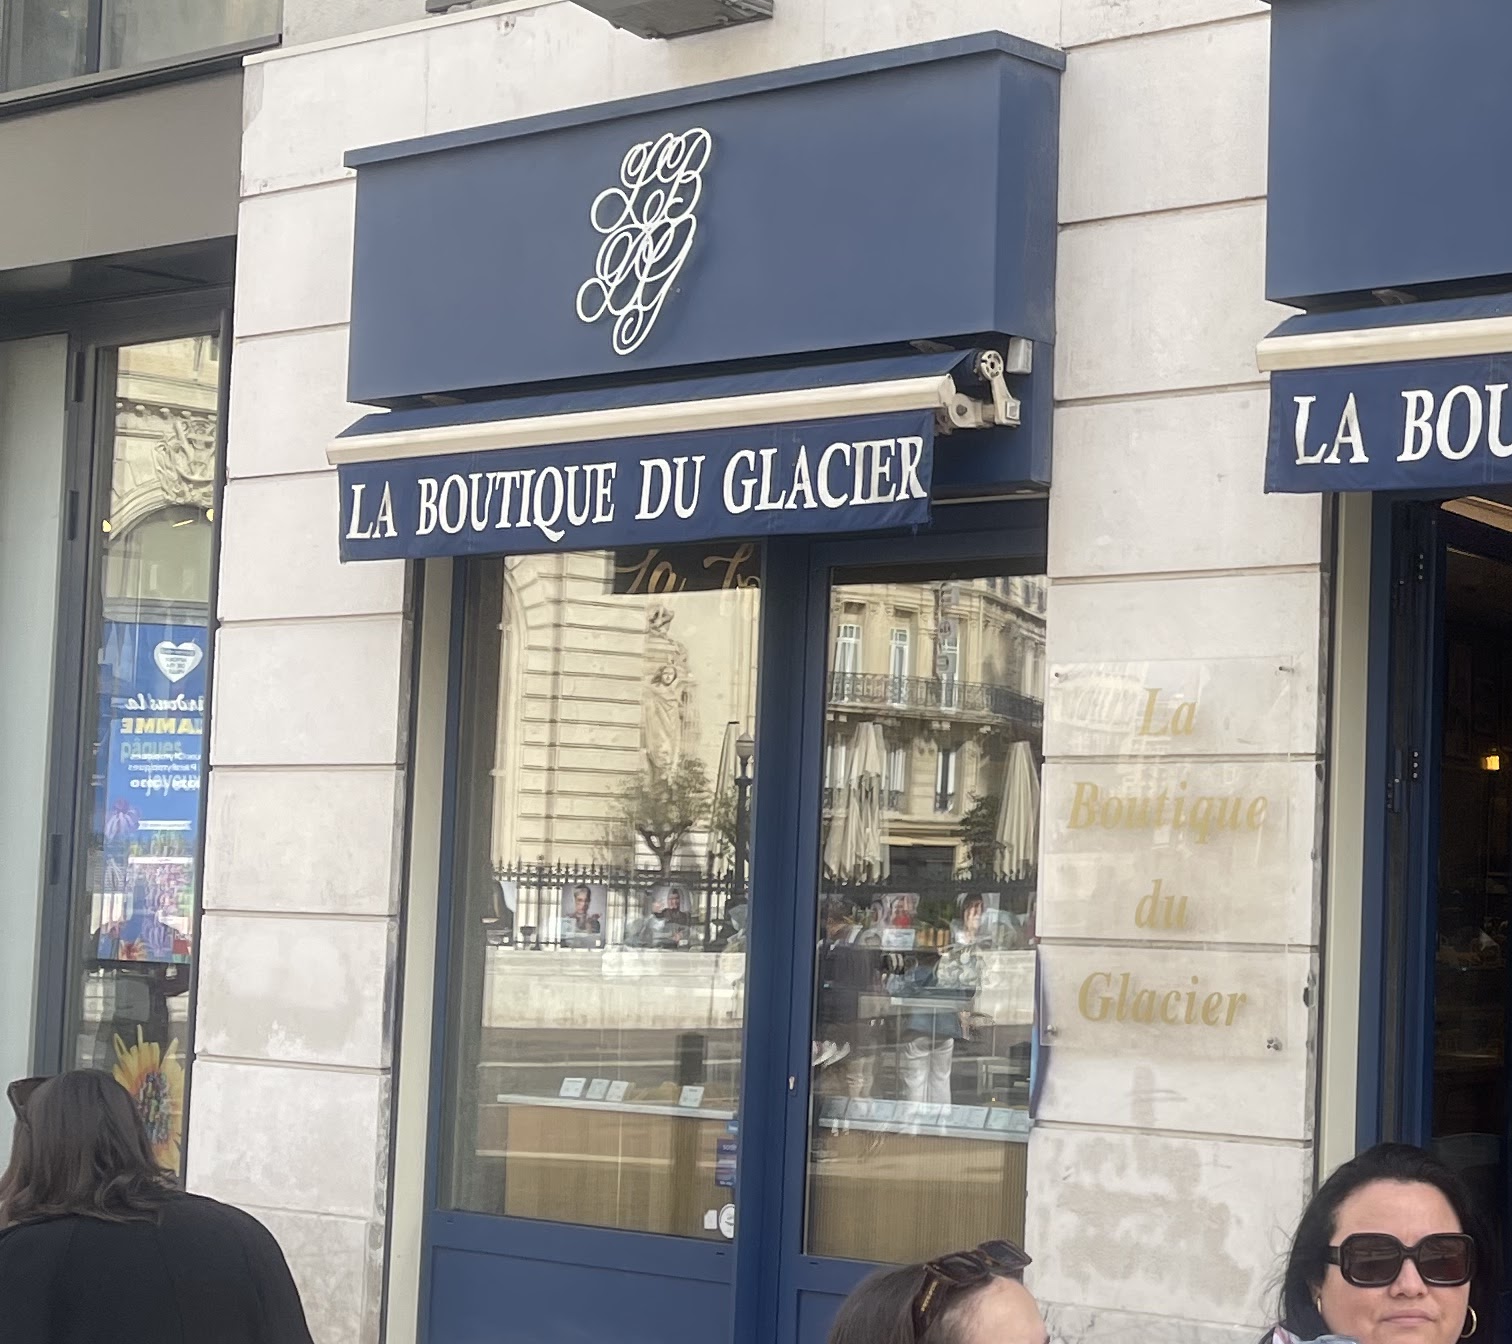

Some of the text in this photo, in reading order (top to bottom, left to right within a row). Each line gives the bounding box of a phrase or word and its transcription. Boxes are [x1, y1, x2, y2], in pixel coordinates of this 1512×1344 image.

[1293, 395, 1369, 465] LA
[345, 435, 928, 542] LA BOUTIQUE DU GLACIER
[1138, 687, 1197, 737] La
[1066, 780, 1268, 844] Boutique
[1135, 878, 1189, 930] du
[1078, 971, 1248, 1027] Glacier
